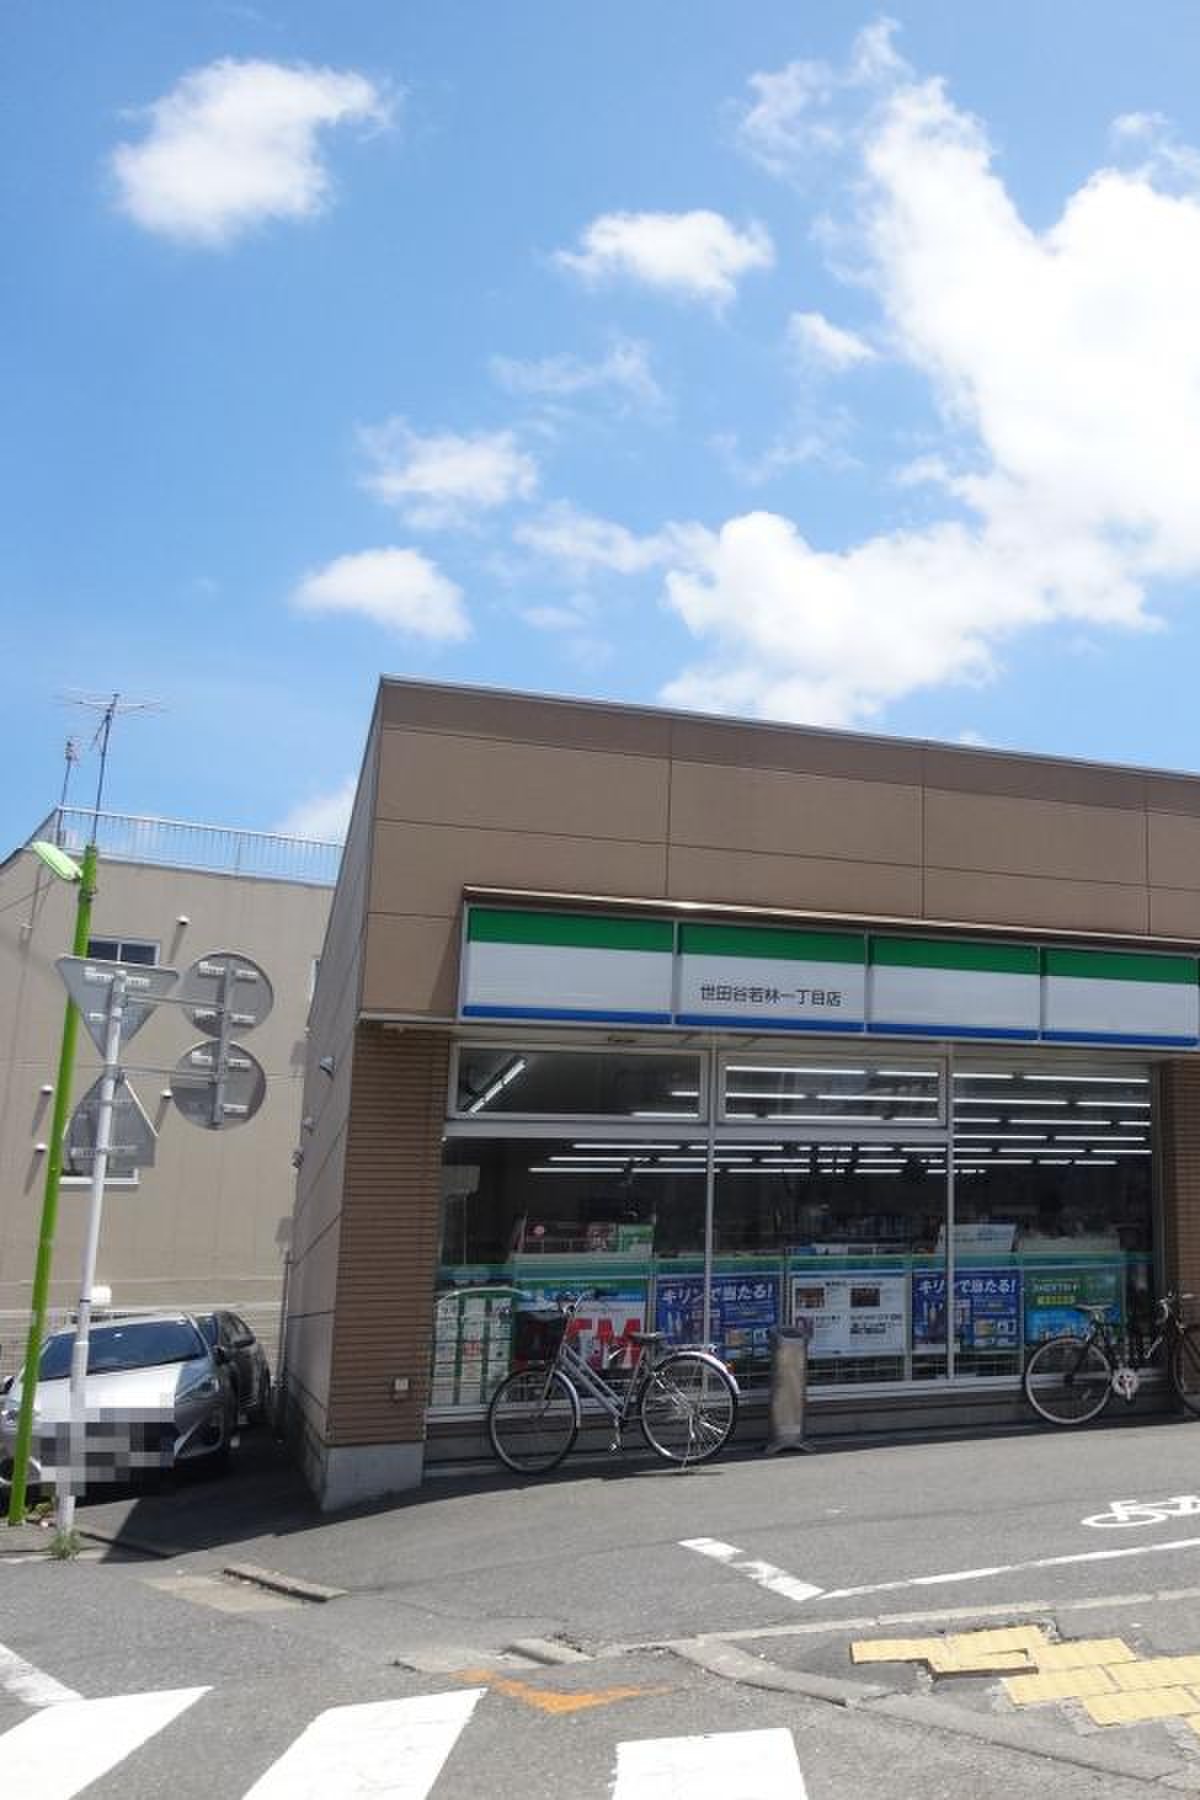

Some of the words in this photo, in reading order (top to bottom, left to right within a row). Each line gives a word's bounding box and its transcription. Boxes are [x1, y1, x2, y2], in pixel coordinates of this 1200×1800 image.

[700, 984, 842, 1007] 世田谷若林一丁目店
[919, 1279, 1016, 1296] キリで当たる!
